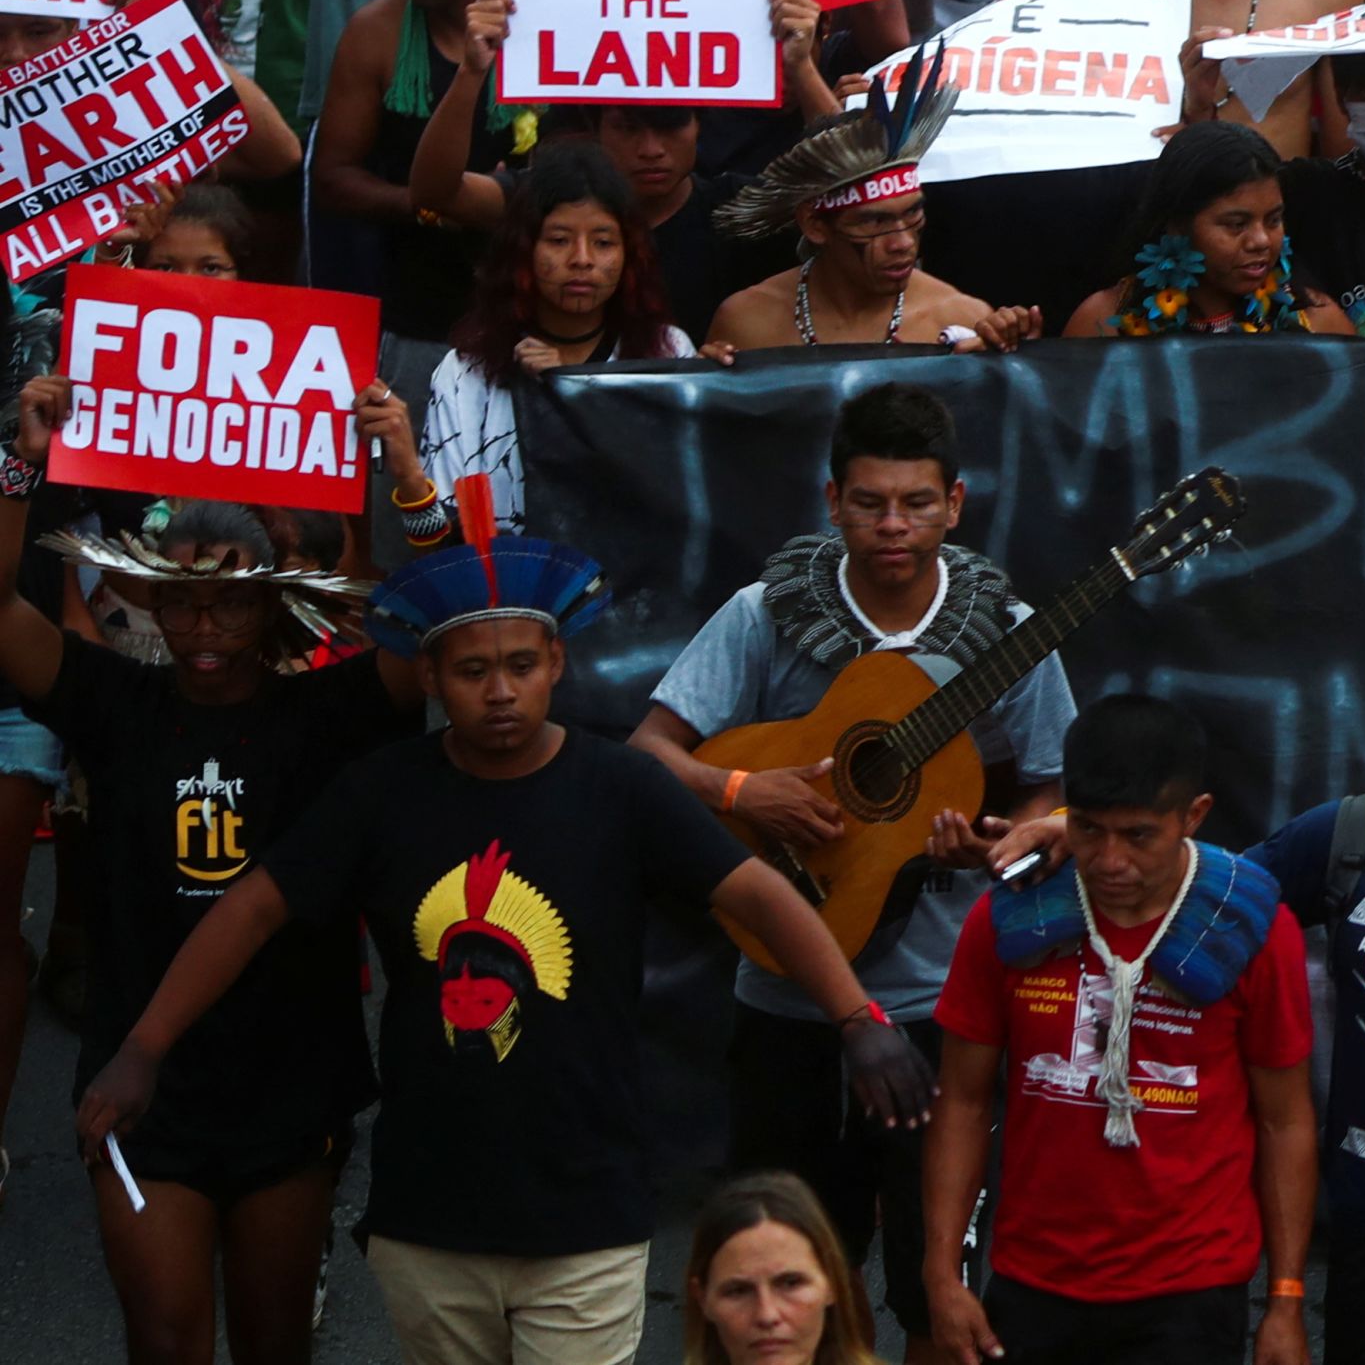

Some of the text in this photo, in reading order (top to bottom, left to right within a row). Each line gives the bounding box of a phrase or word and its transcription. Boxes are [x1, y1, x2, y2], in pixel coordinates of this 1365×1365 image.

[9, 11, 132, 84] BATTLE FOR
[536, 29, 742, 89] LAND
[20, 107, 207, 219] IS THE MOTHER OF
[2, 217, 84, 282] ALL
[67, 297, 356, 412] FORA
[61, 383, 359, 478] GENOCIDA!
[175, 799, 246, 859] fit
[1014, 987, 1076, 1002] TEMPORAL
[1023, 976, 1066, 988] MARCO
